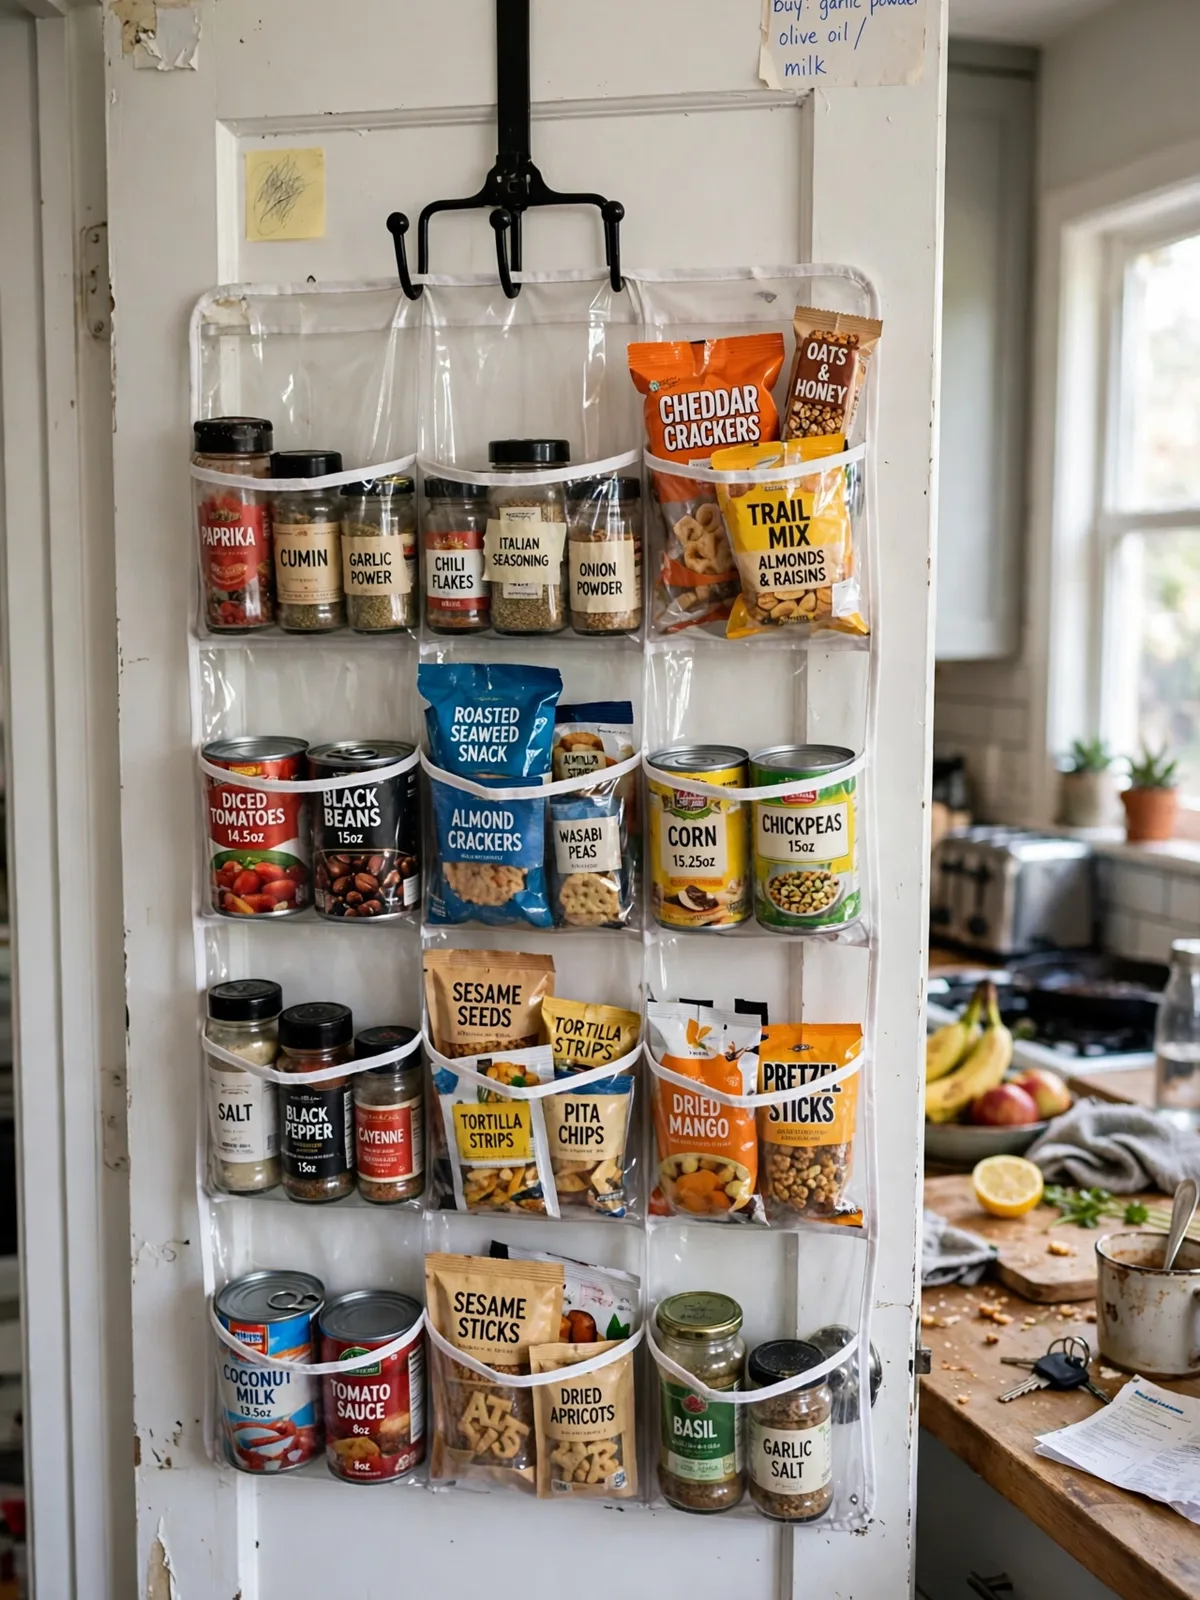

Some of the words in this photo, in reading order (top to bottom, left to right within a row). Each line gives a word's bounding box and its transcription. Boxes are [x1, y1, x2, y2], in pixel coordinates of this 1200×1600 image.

[774, 0, 809, 21] buy:
[779, 25, 818, 45] olive
[828, 22, 848, 42] oil
[785, 55, 827, 76] milk
[807, 341, 848, 366] OATS
[817, 364, 830, 382] &
[795, 379, 848, 405] HONEY
[659, 384, 760, 425] CHEDDAR
[664, 415, 760, 452] CRACKERS
[747, 498, 811, 526] TRAIL
[201, 526, 256, 547] PAPRIKA
[499, 537, 540, 550] ITALIAN
[768, 523, 811, 549] MIX
[280, 549, 328, 567] CUMIN
[350, 552, 392, 567] GARLIC
[435, 557, 465, 572] CHILI
[492, 553, 549, 567] SEASONING
[758, 550, 825, 571] ALMONDS
[351, 570, 392, 585] POWER
[579, 562, 617, 577] ONION
[759, 572, 770, 587] &
[773, 567, 827, 586] RAISINS
[432, 575, 474, 590] FLAKES
[577, 581, 623, 596] POWDER
[454, 706, 520, 724] ROASTED
[450, 725, 520, 743] SEAWEED
[458, 744, 508, 763] SNACK
[222, 792, 268, 809] DICED
[323, 788, 379, 808] BLACK
[210, 808, 286, 827] TOMATOES
[324, 808, 382, 828] BEANS
[451, 808, 514, 829] ALMOND
[762, 813, 843, 836] CHICKPEAS
[228, 829, 265, 843] 14.5oz
[337, 831, 364, 844] 15oz
[447, 830, 523, 852] CRACKERS
[558, 826, 603, 844] WASABI
[667, 825, 717, 848] CORN
[568, 844, 598, 860] PEAS
[788, 840, 815, 853] 15oz
[673, 854, 716, 869] 15.25oz
[452, 982, 522, 1005] SESAME
[457, 1006, 512, 1028] SEEDS
[553, 1016, 622, 1042] TORTILLA
[553, 1037, 614, 1061] STRIPS
[218, 1103, 253, 1122] SALT
[286, 1105, 329, 1123] BLACK
[564, 1103, 601, 1123] PITA
[672, 1094, 721, 1117] DRIED
[769, 1096, 834, 1123] STICKS
[285, 1122, 333, 1140] PEPPER
[460, 1113, 522, 1130] TORTILLA
[669, 1114, 730, 1138] MANGO
[358, 1128, 404, 1144] CAYENNE
[469, 1132, 515, 1149] STRIPS
[558, 1124, 605, 1146] CHIPS
[453, 1291, 527, 1320] SESAME
[457, 1317, 520, 1344] STICKS
[236, 1386, 275, 1405] MILK
[330, 1379, 391, 1400] TOMATO
[560, 1387, 602, 1405] DRIED
[240, 1406, 271, 1417] 13.5oz
[337, 1401, 385, 1420] SAUCE
[550, 1405, 615, 1425] APRICOTS
[352, 1424, 370, 1434] 8oz
[673, 1416, 718, 1439] BASIL
[763, 1438, 812, 1458] GARLIC
[771, 1461, 804, 1479] SALT
